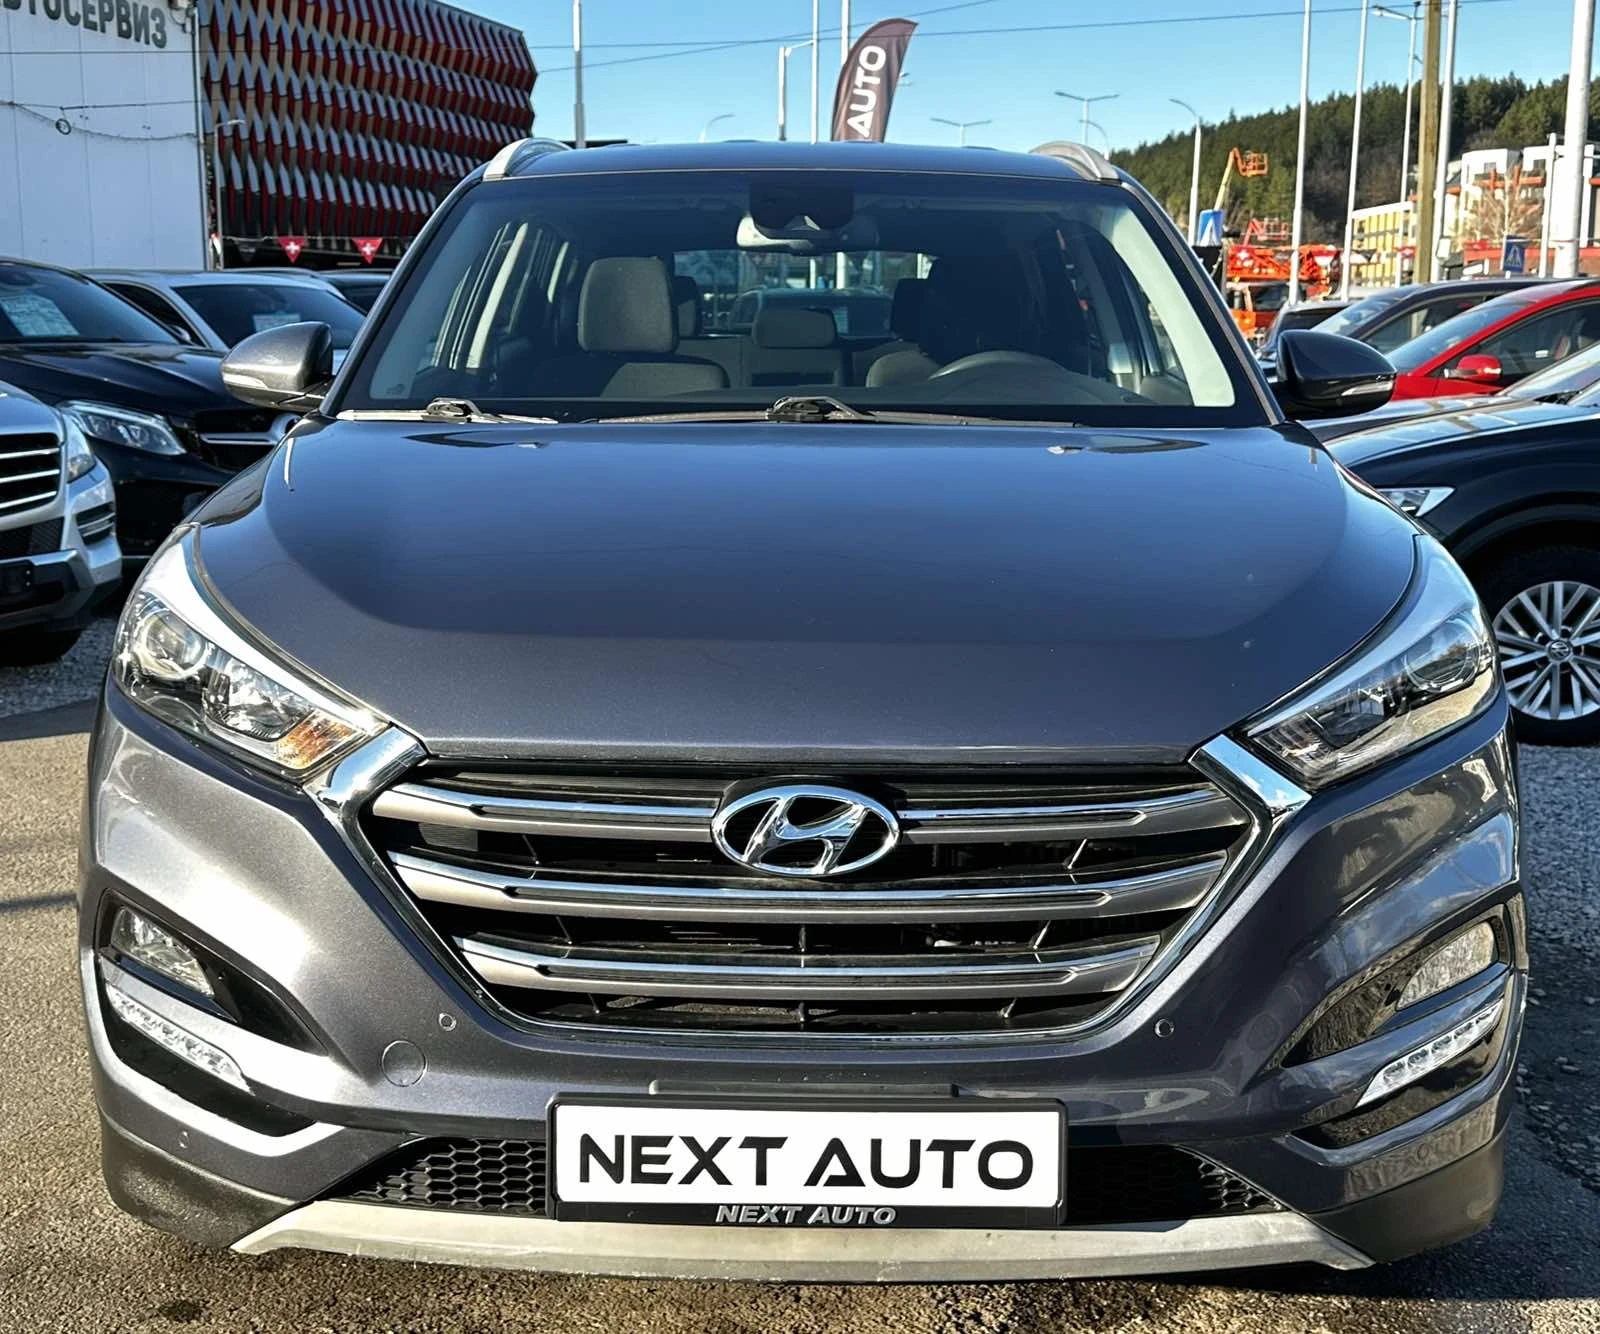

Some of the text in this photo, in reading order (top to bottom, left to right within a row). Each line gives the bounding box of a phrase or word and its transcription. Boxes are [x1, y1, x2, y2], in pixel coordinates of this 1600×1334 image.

[847, 45, 886, 138] AUTO
[579, 1133, 1034, 1191] NEXT AUTO
[715, 1204, 897, 1225] NEXT AUTO
